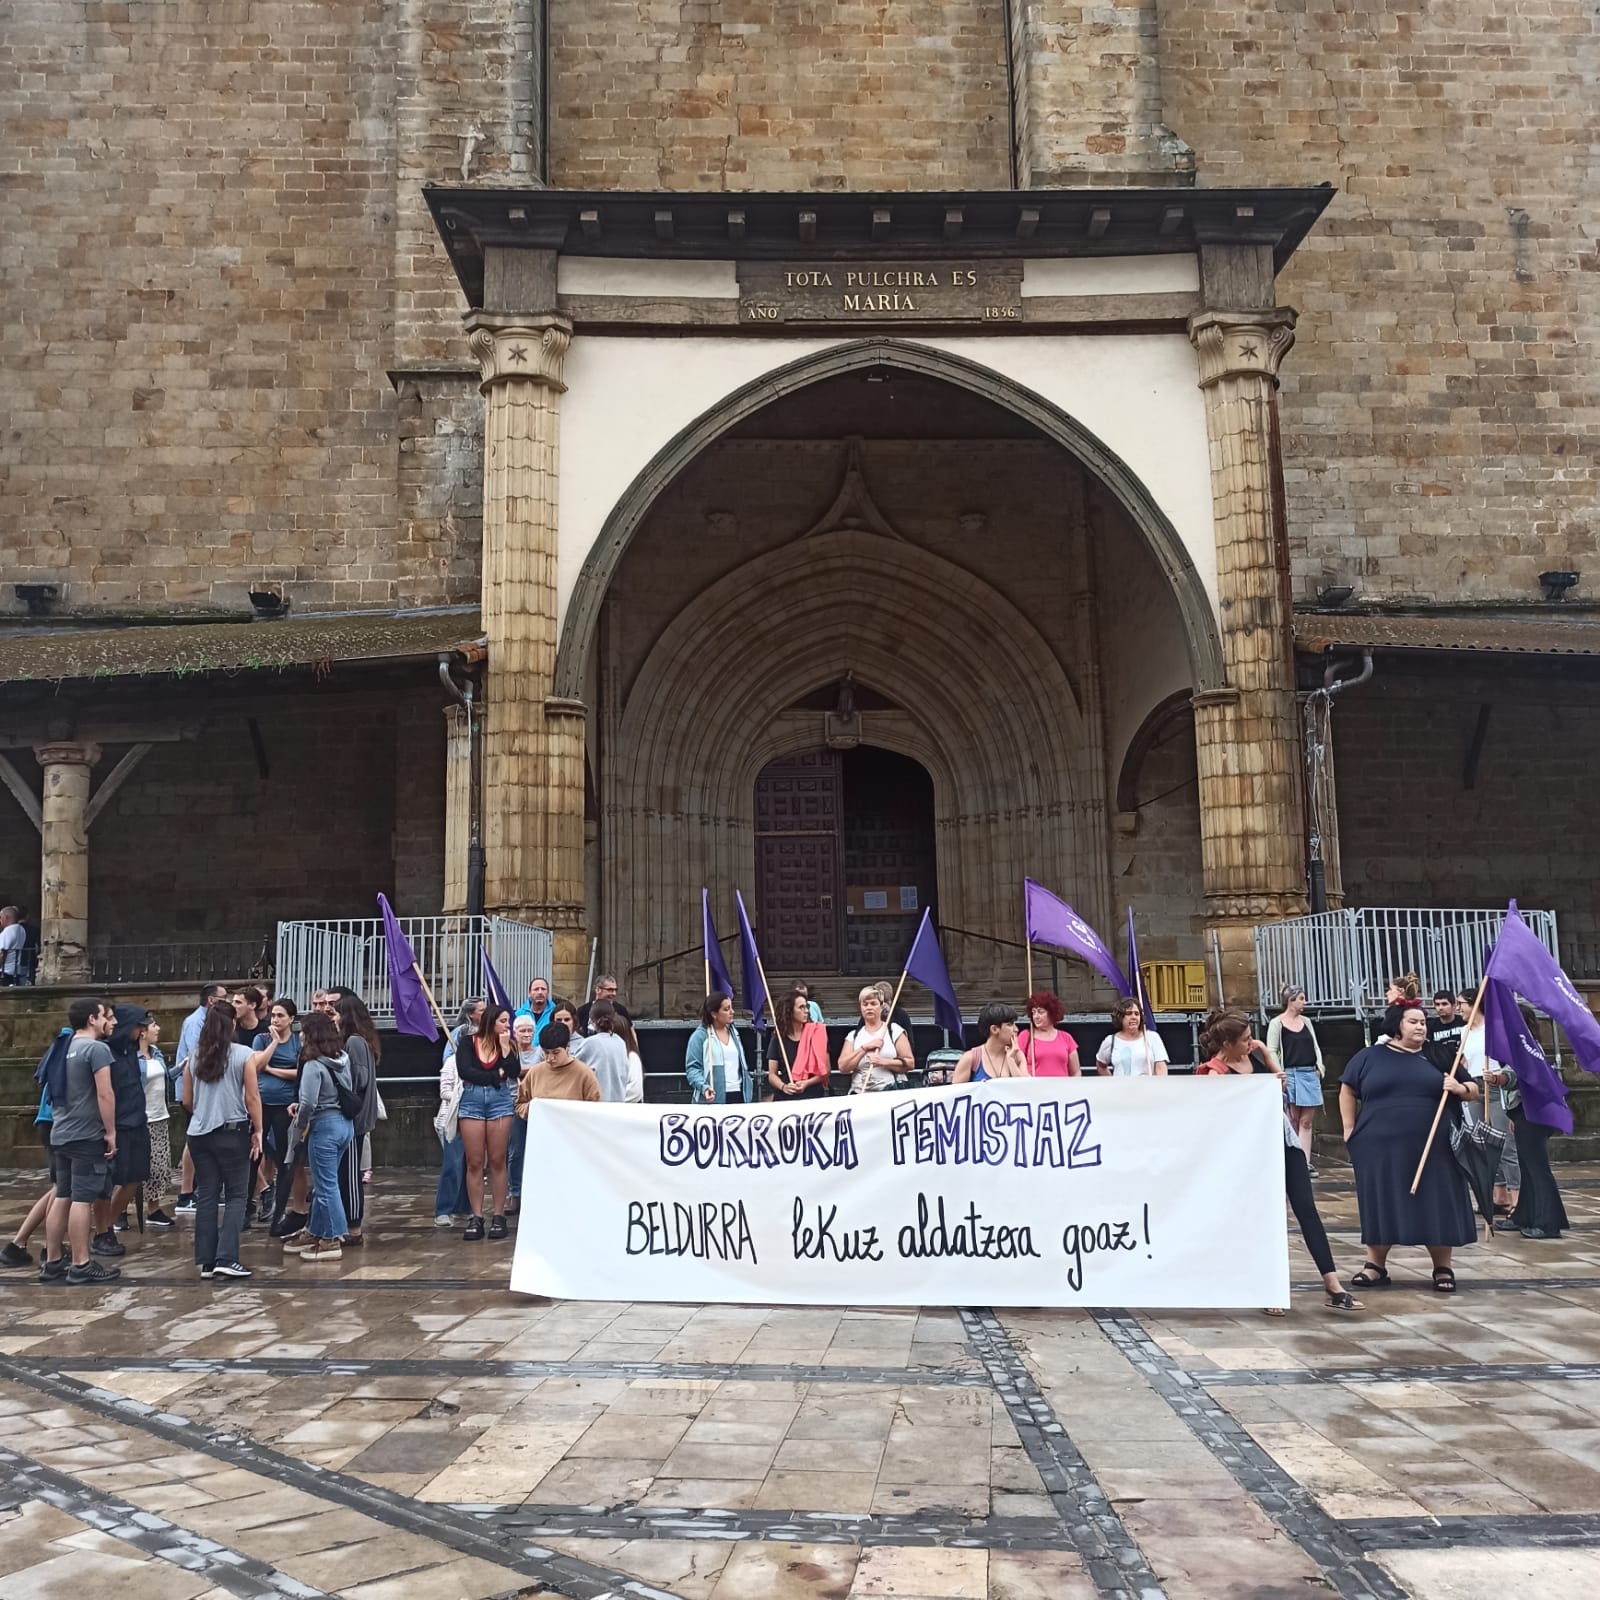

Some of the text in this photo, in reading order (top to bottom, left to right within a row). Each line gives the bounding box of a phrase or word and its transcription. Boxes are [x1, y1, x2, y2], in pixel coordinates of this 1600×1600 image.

[784, 271, 977, 286] TOTA PULCHRA ES
[844, 290, 920, 311] MARÍA.
[660, 1095, 1102, 1170] BORROKA FEMISTAZ
[626, 1199, 758, 1265] BELDURRA
[898, 1192, 1042, 1260] aldatzera
